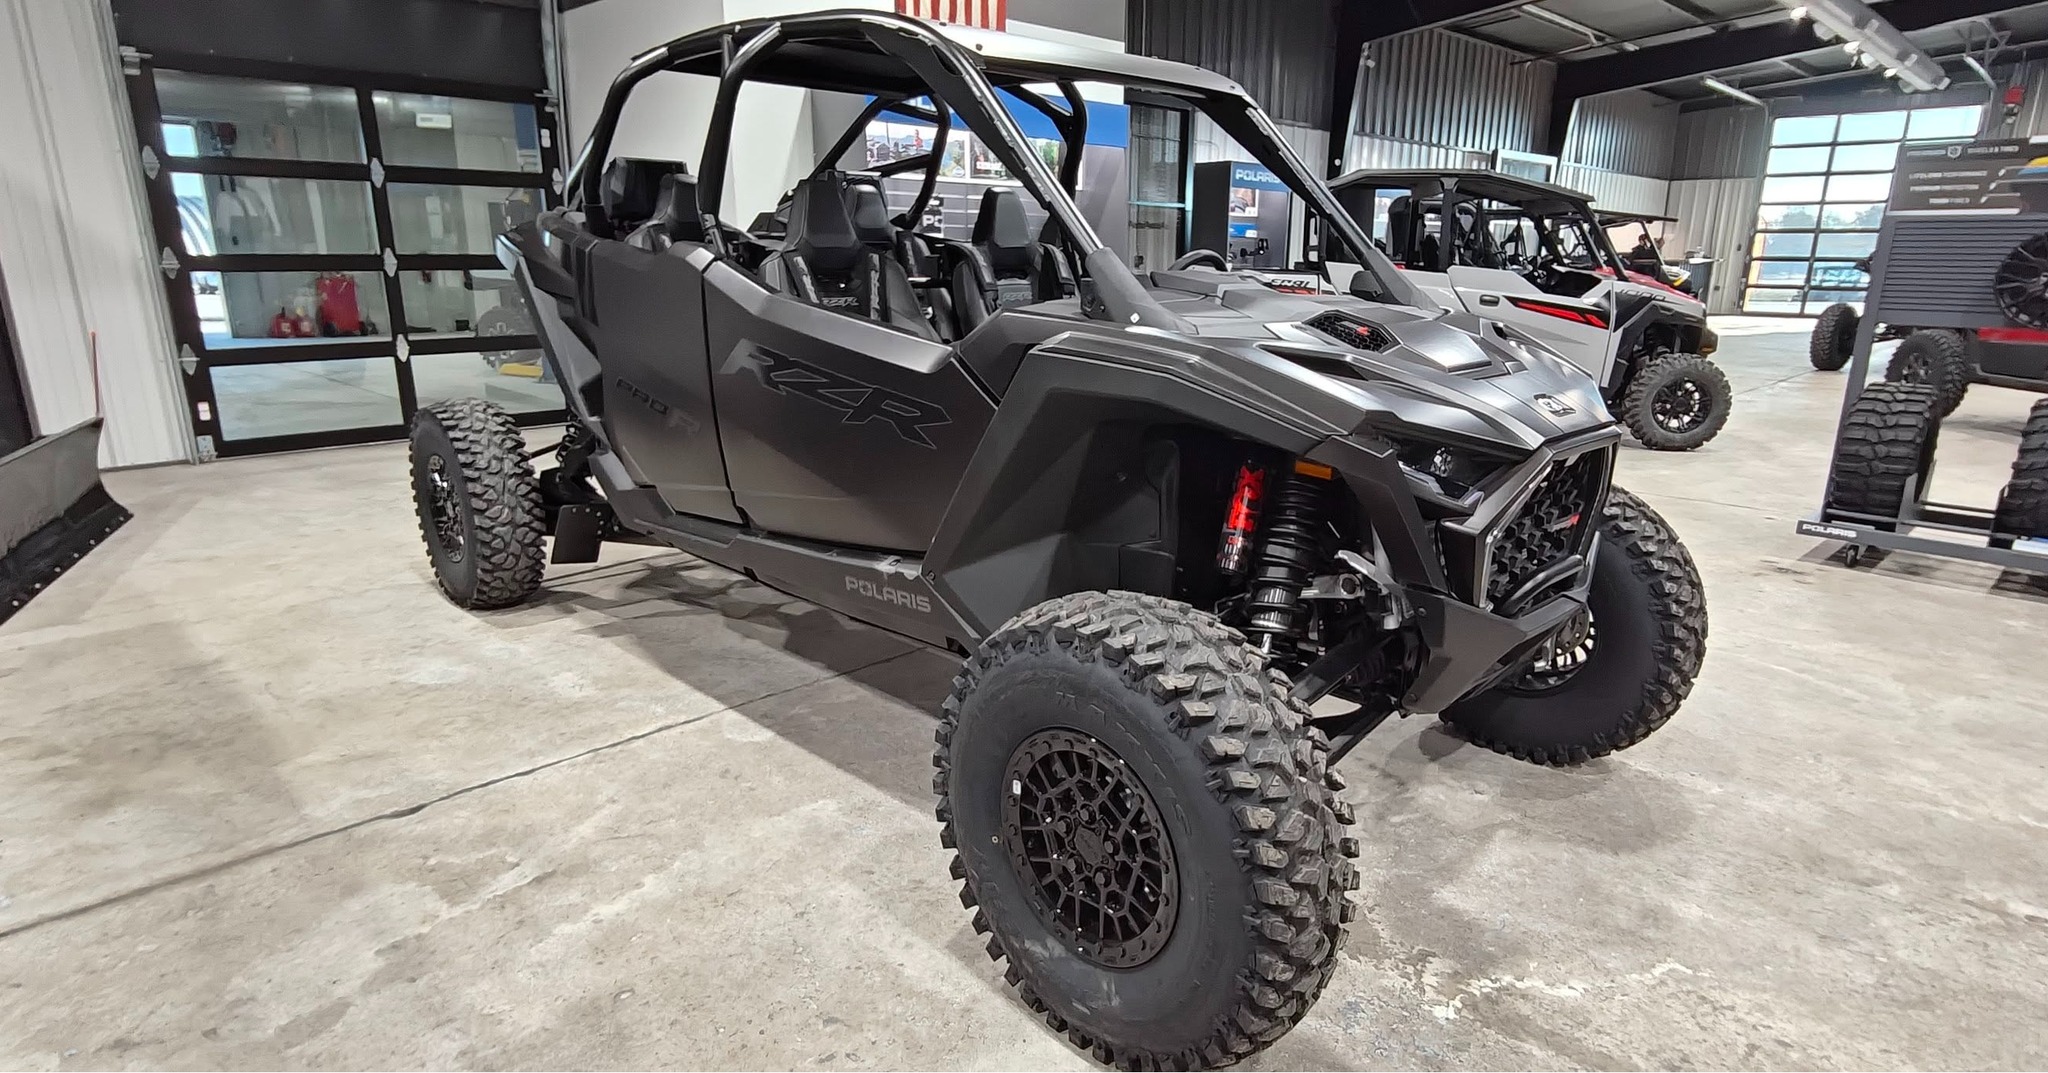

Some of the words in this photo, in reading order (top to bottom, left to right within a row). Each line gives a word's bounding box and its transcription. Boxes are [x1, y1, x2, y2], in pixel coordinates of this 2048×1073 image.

[720, 338, 953, 450] RZR
[1801, 523, 1858, 538] POLARIS
[845, 576, 932, 613] POLARIS
